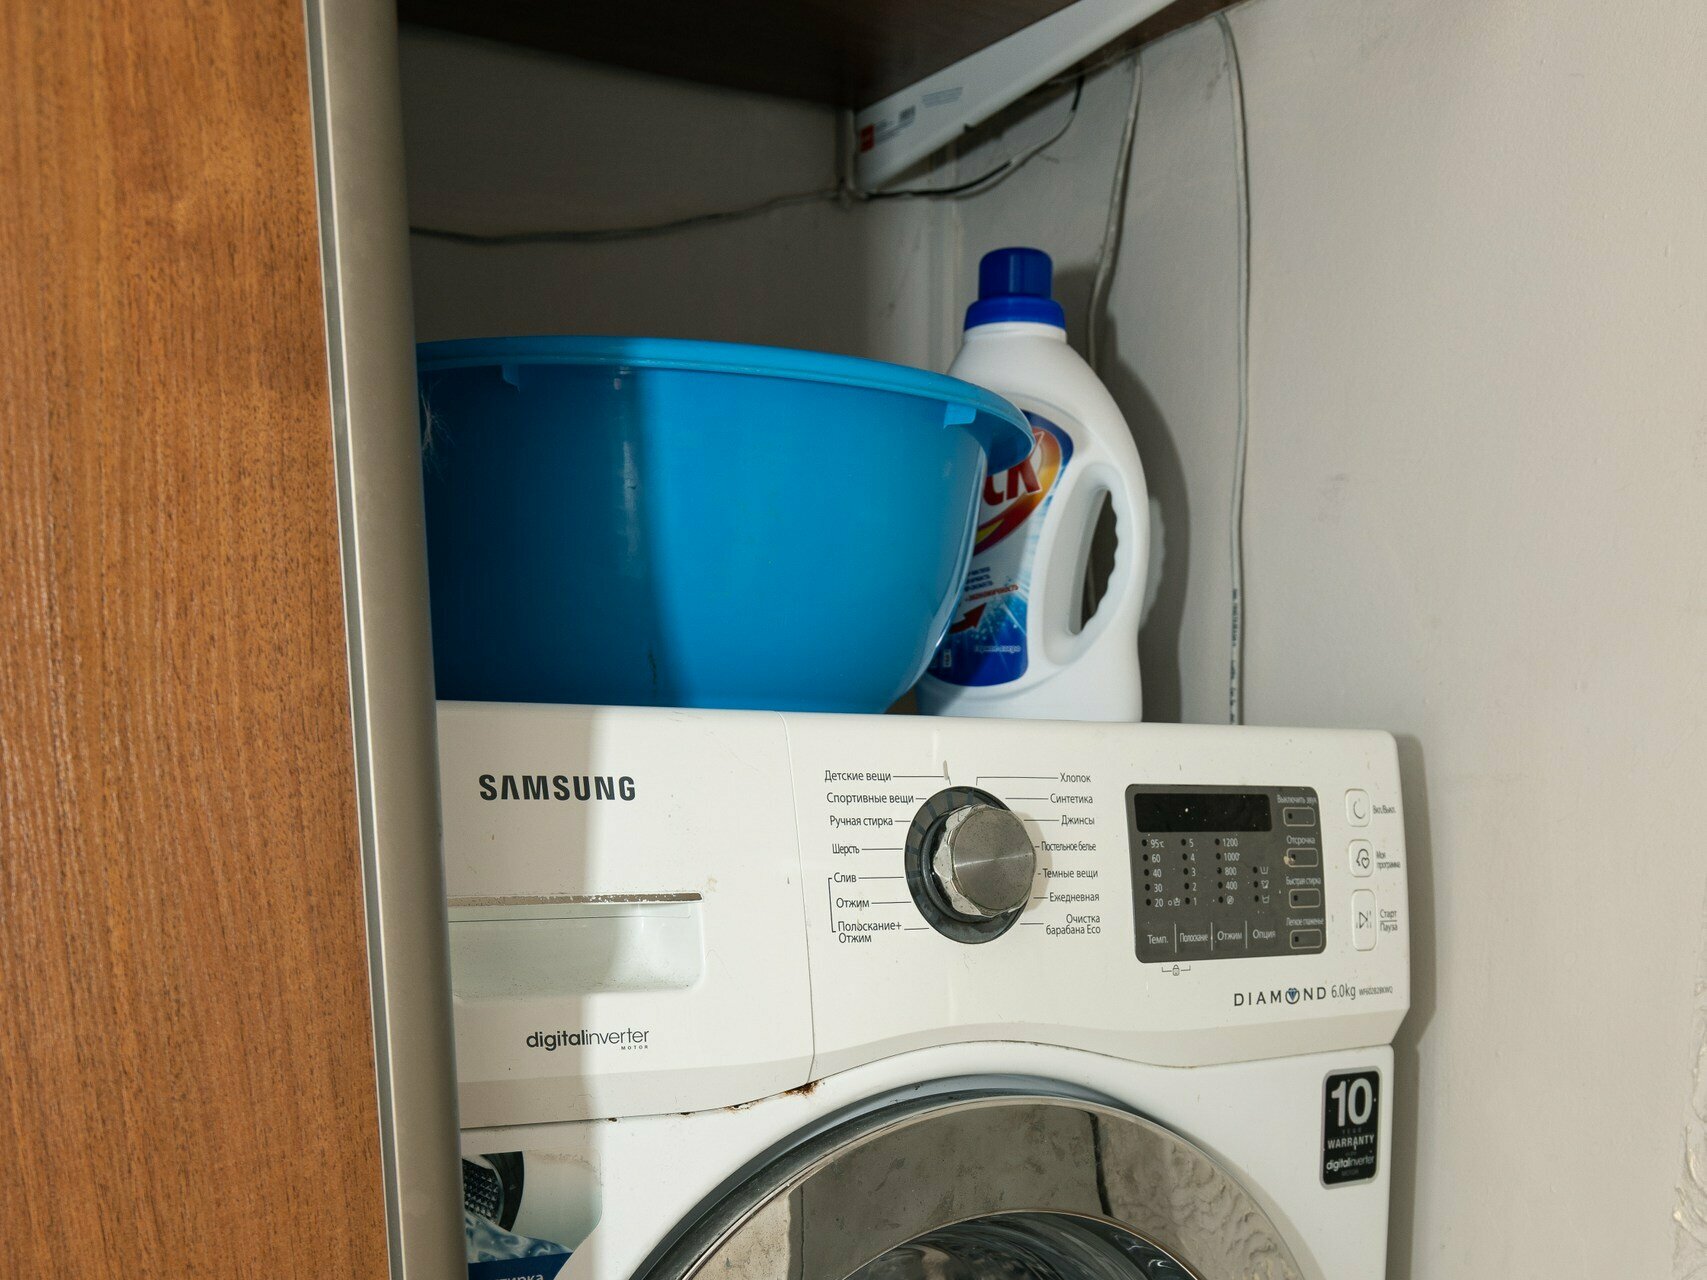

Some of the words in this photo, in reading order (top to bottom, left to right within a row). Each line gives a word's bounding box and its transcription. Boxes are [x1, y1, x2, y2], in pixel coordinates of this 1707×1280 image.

[825, 770, 864, 782] Детские
[866, 773, 891, 782] вещи
[1060, 772, 1091, 783] Хлопок
[479, 774, 636, 801] SAMSUNG
[826, 792, 887, 805] Спортивные
[889, 794, 914, 804] вещи
[1050, 793, 1093, 803] Синтетика
[829, 815, 861, 828] Ручная
[863, 817, 893, 828] стирка
[1061, 815, 1095, 827] Джинсы
[1189, 838, 1194, 848] 5
[1223, 838, 1239, 848] 1200
[1286, 835, 1315, 845] Отсрочка
[832, 843, 860, 856] Шерсть
[1041, 841, 1078, 851] Постельное
[1078, 841, 1096, 851] белье
[1151, 853, 1161, 863] 60
[1190, 853, 1195, 861] 4
[1224, 852, 1239, 862] 1000
[1042, 868, 1074, 878] Темные
[1076, 870, 1098, 879] вещи
[1152, 868, 1162, 878] 40
[1191, 867, 1196, 877] 3
[1224, 867, 1237, 876] 800
[833, 872, 857, 883] Слив
[1154, 883, 1163, 893] 30
[1192, 882, 1197, 892] 2
[1225, 881, 1238, 890] 400
[836, 897, 869, 908] Отжим
[1049, 892, 1100, 903] Ежедневная
[1154, 898, 1164, 908] 20
[1193, 897, 1197, 906] 1
[1066, 913, 1100, 924] Очистка
[1380, 908, 1397, 919] Старт
[1046, 925, 1085, 937] барабана
[1087, 924, 1101, 934] Eco
[1380, 923, 1398, 934] Пауза
[839, 933, 872, 943] Отжим
[1147, 934, 1168, 945] Темп.
[1180, 932, 1208, 943] Полоскание
[1217, 930, 1242, 941] Отжим
[1252, 929, 1276, 941] Опция
[1234, 986, 1327, 1007] DIAMOND
[1331, 983, 1356, 1000] 6.0kg
[526, 1028, 649, 1051] digitalinverter
[1331, 1077, 1373, 1127] 10
[1327, 1134, 1375, 1149] WARRANTY
